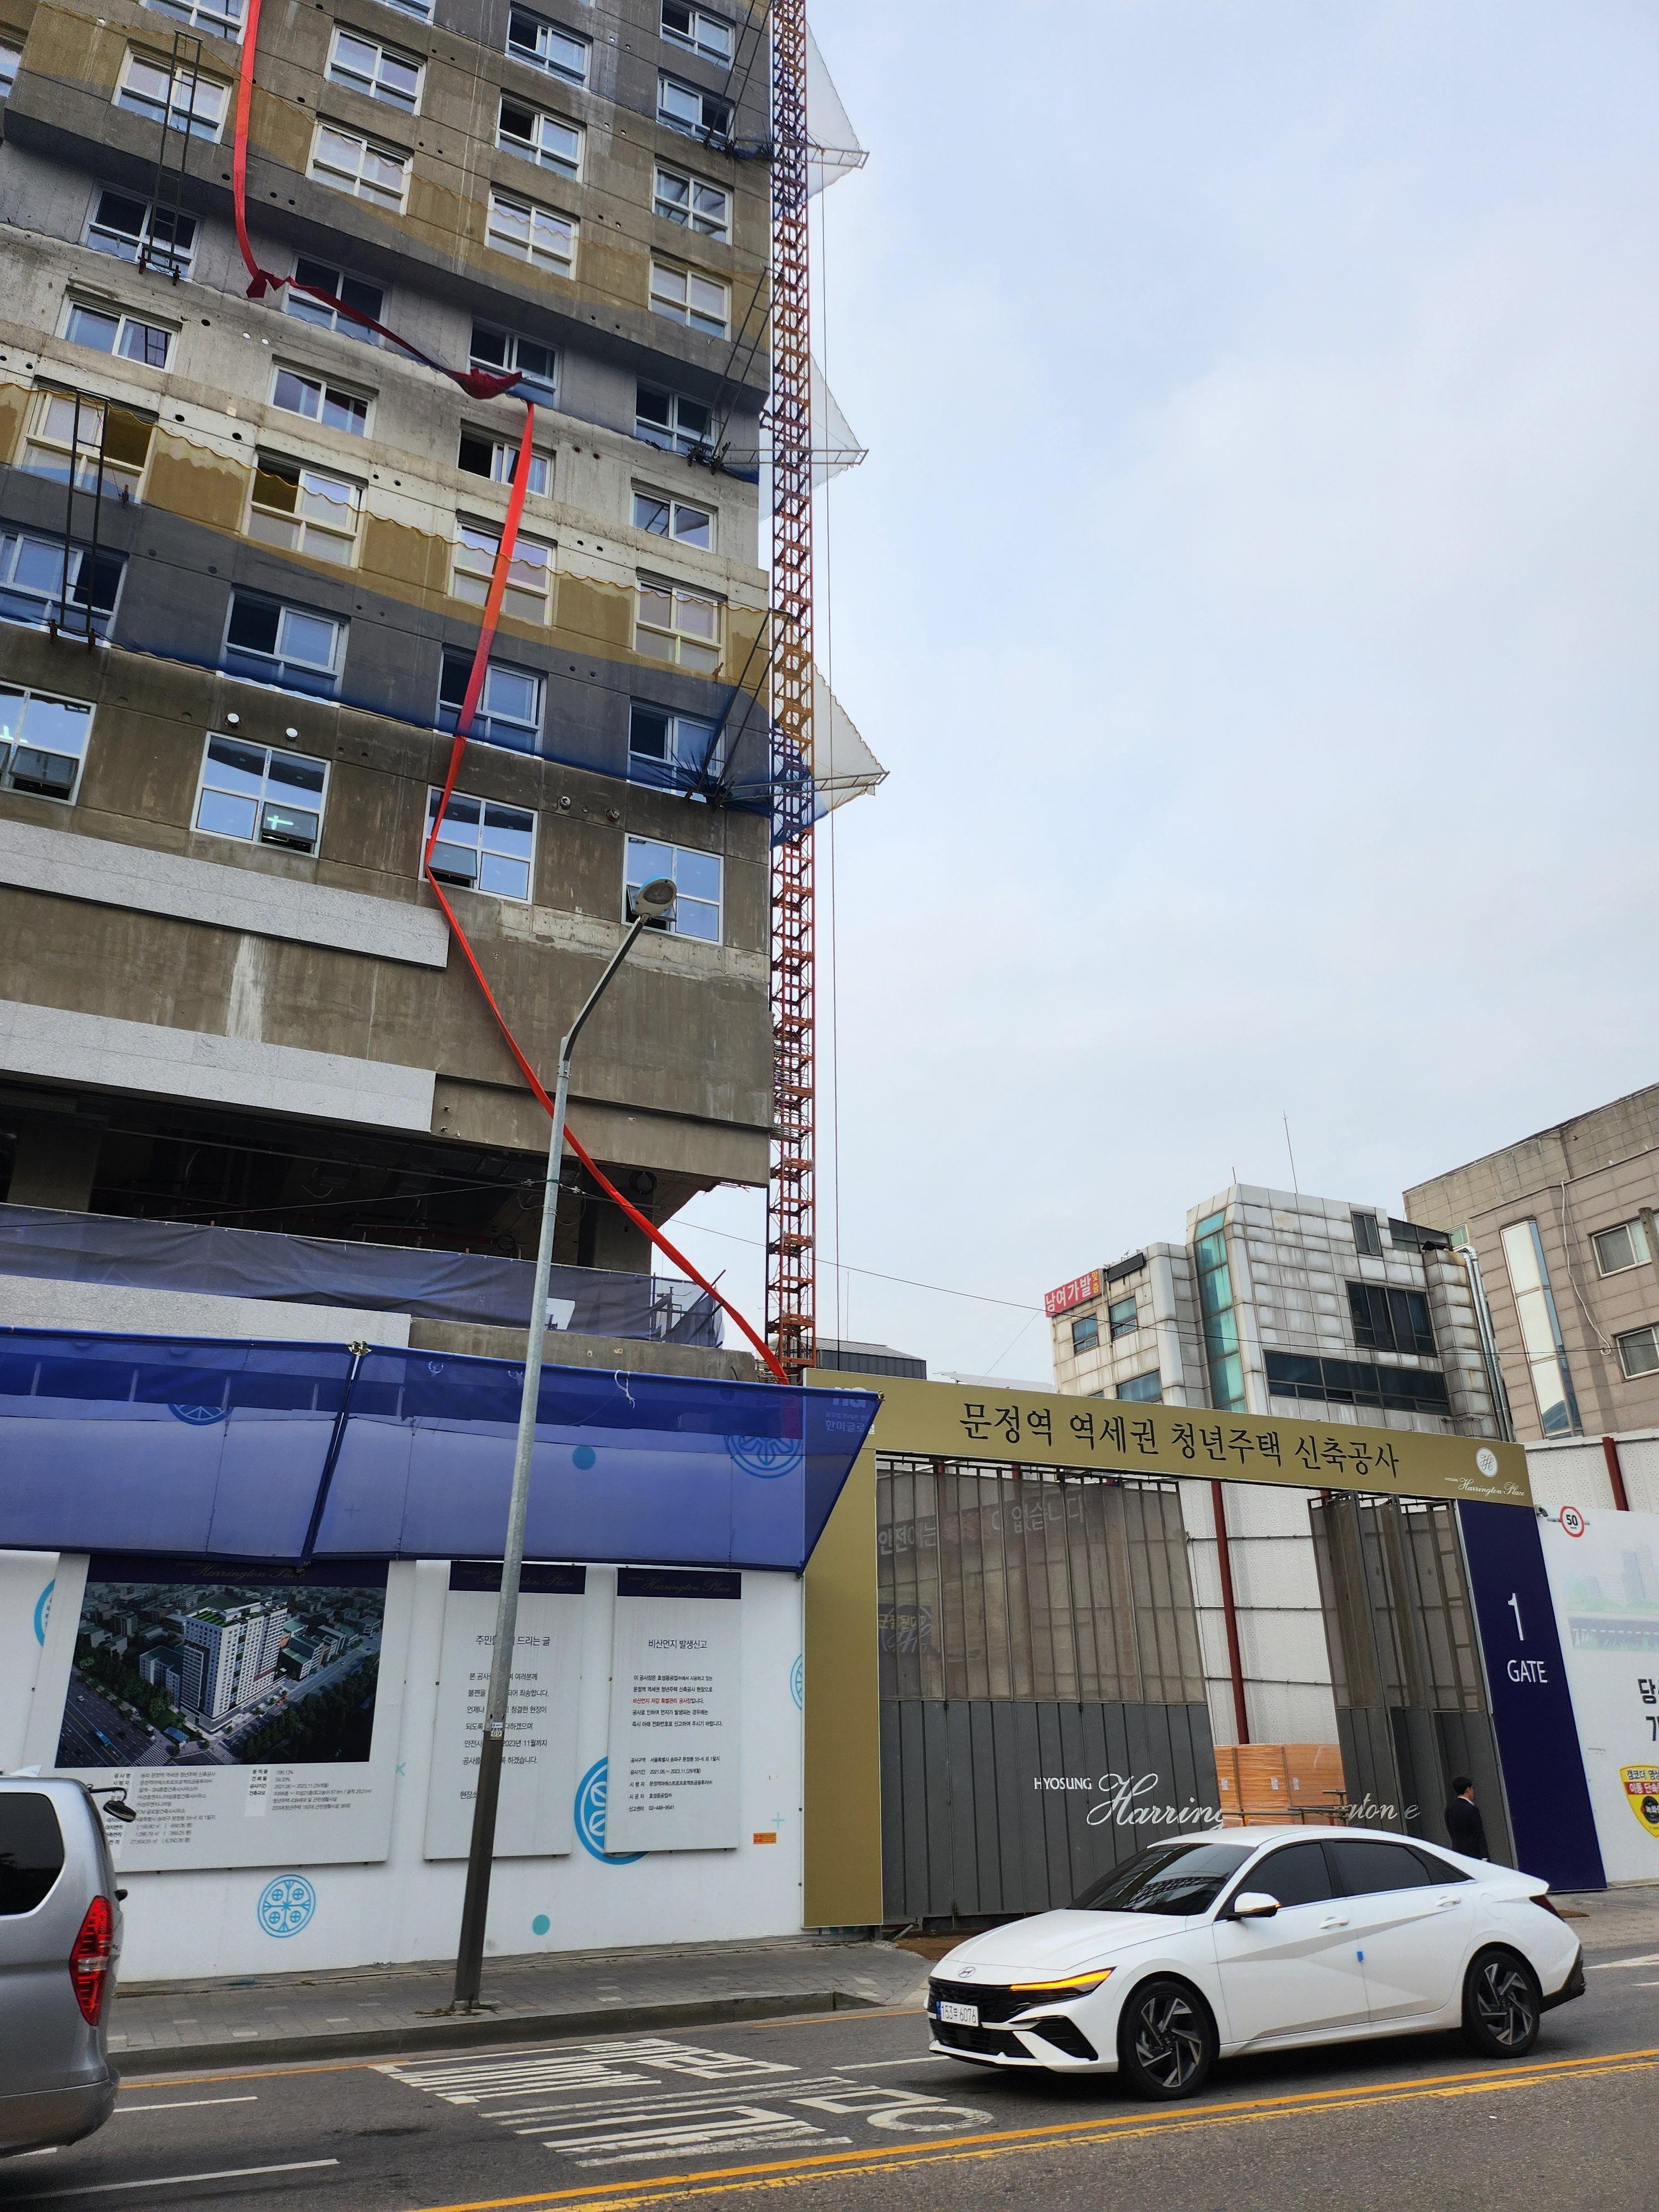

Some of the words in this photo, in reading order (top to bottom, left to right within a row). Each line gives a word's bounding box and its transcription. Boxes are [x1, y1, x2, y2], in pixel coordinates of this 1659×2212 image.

[1045, 1275, 1092, 1312] 남여가발
[959, 1402, 1052, 1447] 문정역
[1069, 1412, 1159, 1455] 역세권
[1171, 1422, 1282, 1468] 청년주택
[1294, 1435, 1399, 1479] 신축공사
[1458, 1477, 1502, 1497] Harrington
[1503, 1481, 1525, 1496] Place
[1566, 1514, 1578, 1526] 50
[1507, 1593, 1524, 1641] 1
[517, 1636, 540, 1646] 드리는
[542, 1636, 550, 1646] 글
[648, 1639, 677, 1649] 비산먼지
[679, 1639, 707, 1650] 발생신고
[1507, 1659, 1548, 1683] GATE
[467, 1705, 485, 1714] 언제나
[511, 1705, 529, 1714] 청결한
[530, 1705, 547, 1714] 현장이
[502, 1739, 521, 1747] 2023년
[1034, 1777, 1093, 1791] HYOSUNG
[959, 2007, 977, 2023] 6076
